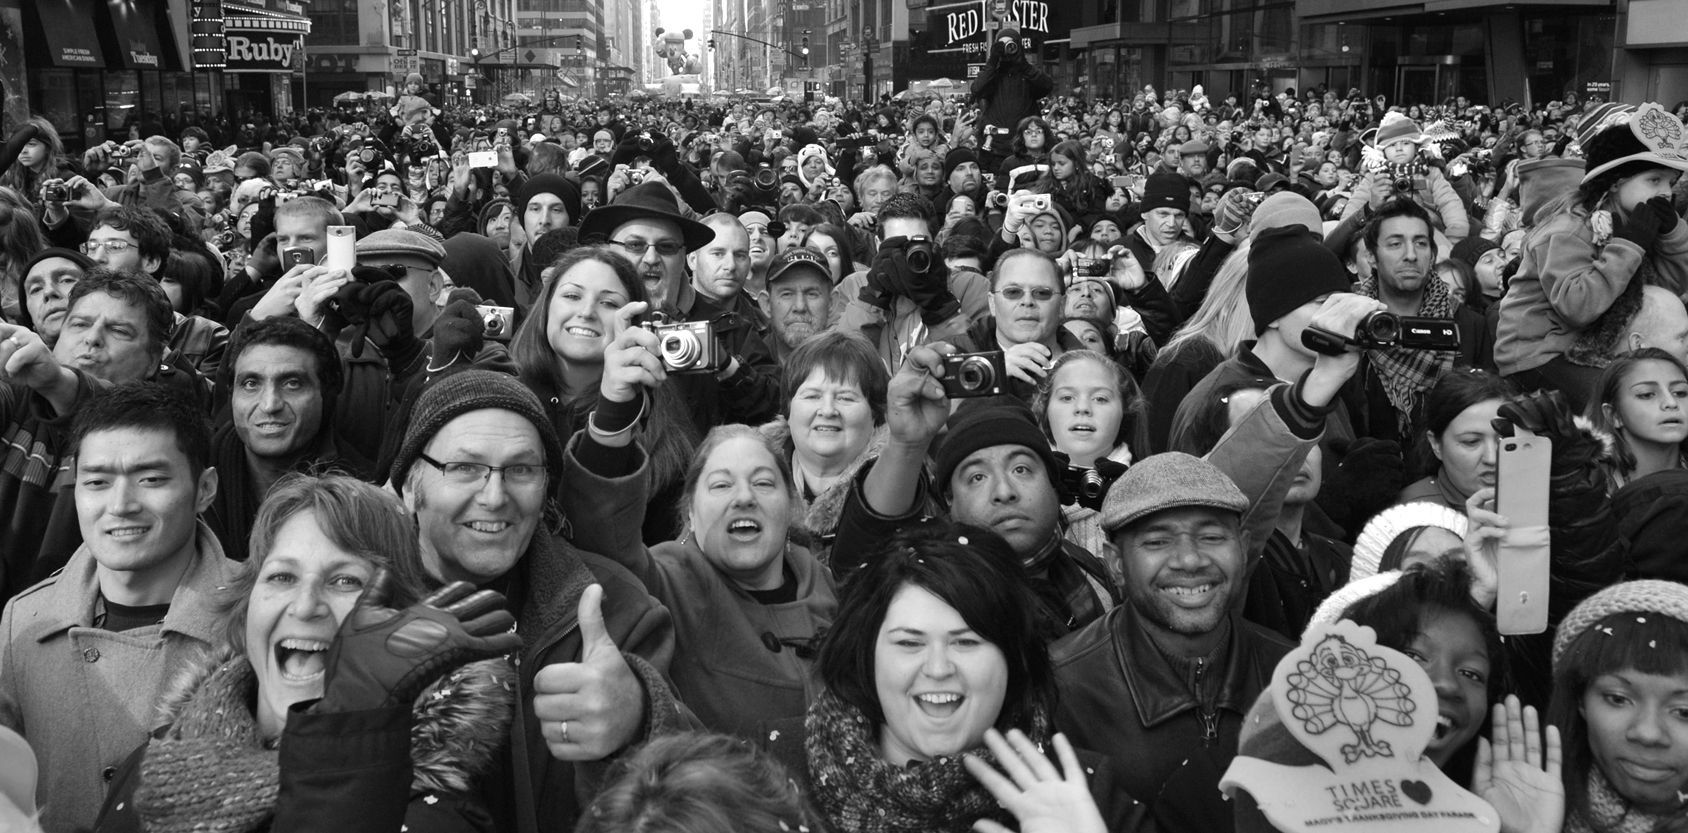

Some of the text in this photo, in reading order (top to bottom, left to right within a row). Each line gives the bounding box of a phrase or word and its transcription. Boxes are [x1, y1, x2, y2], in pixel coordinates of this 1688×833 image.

[947, 0, 1050, 44] RED LSTER
[227, 36, 293, 67] Ruby
[962, 42, 979, 54] FRESH
[130, 51, 158, 67] Tuesday
[1325, 779, 1397, 799] TIMES
[1420, 811, 1438, 819] DAY
